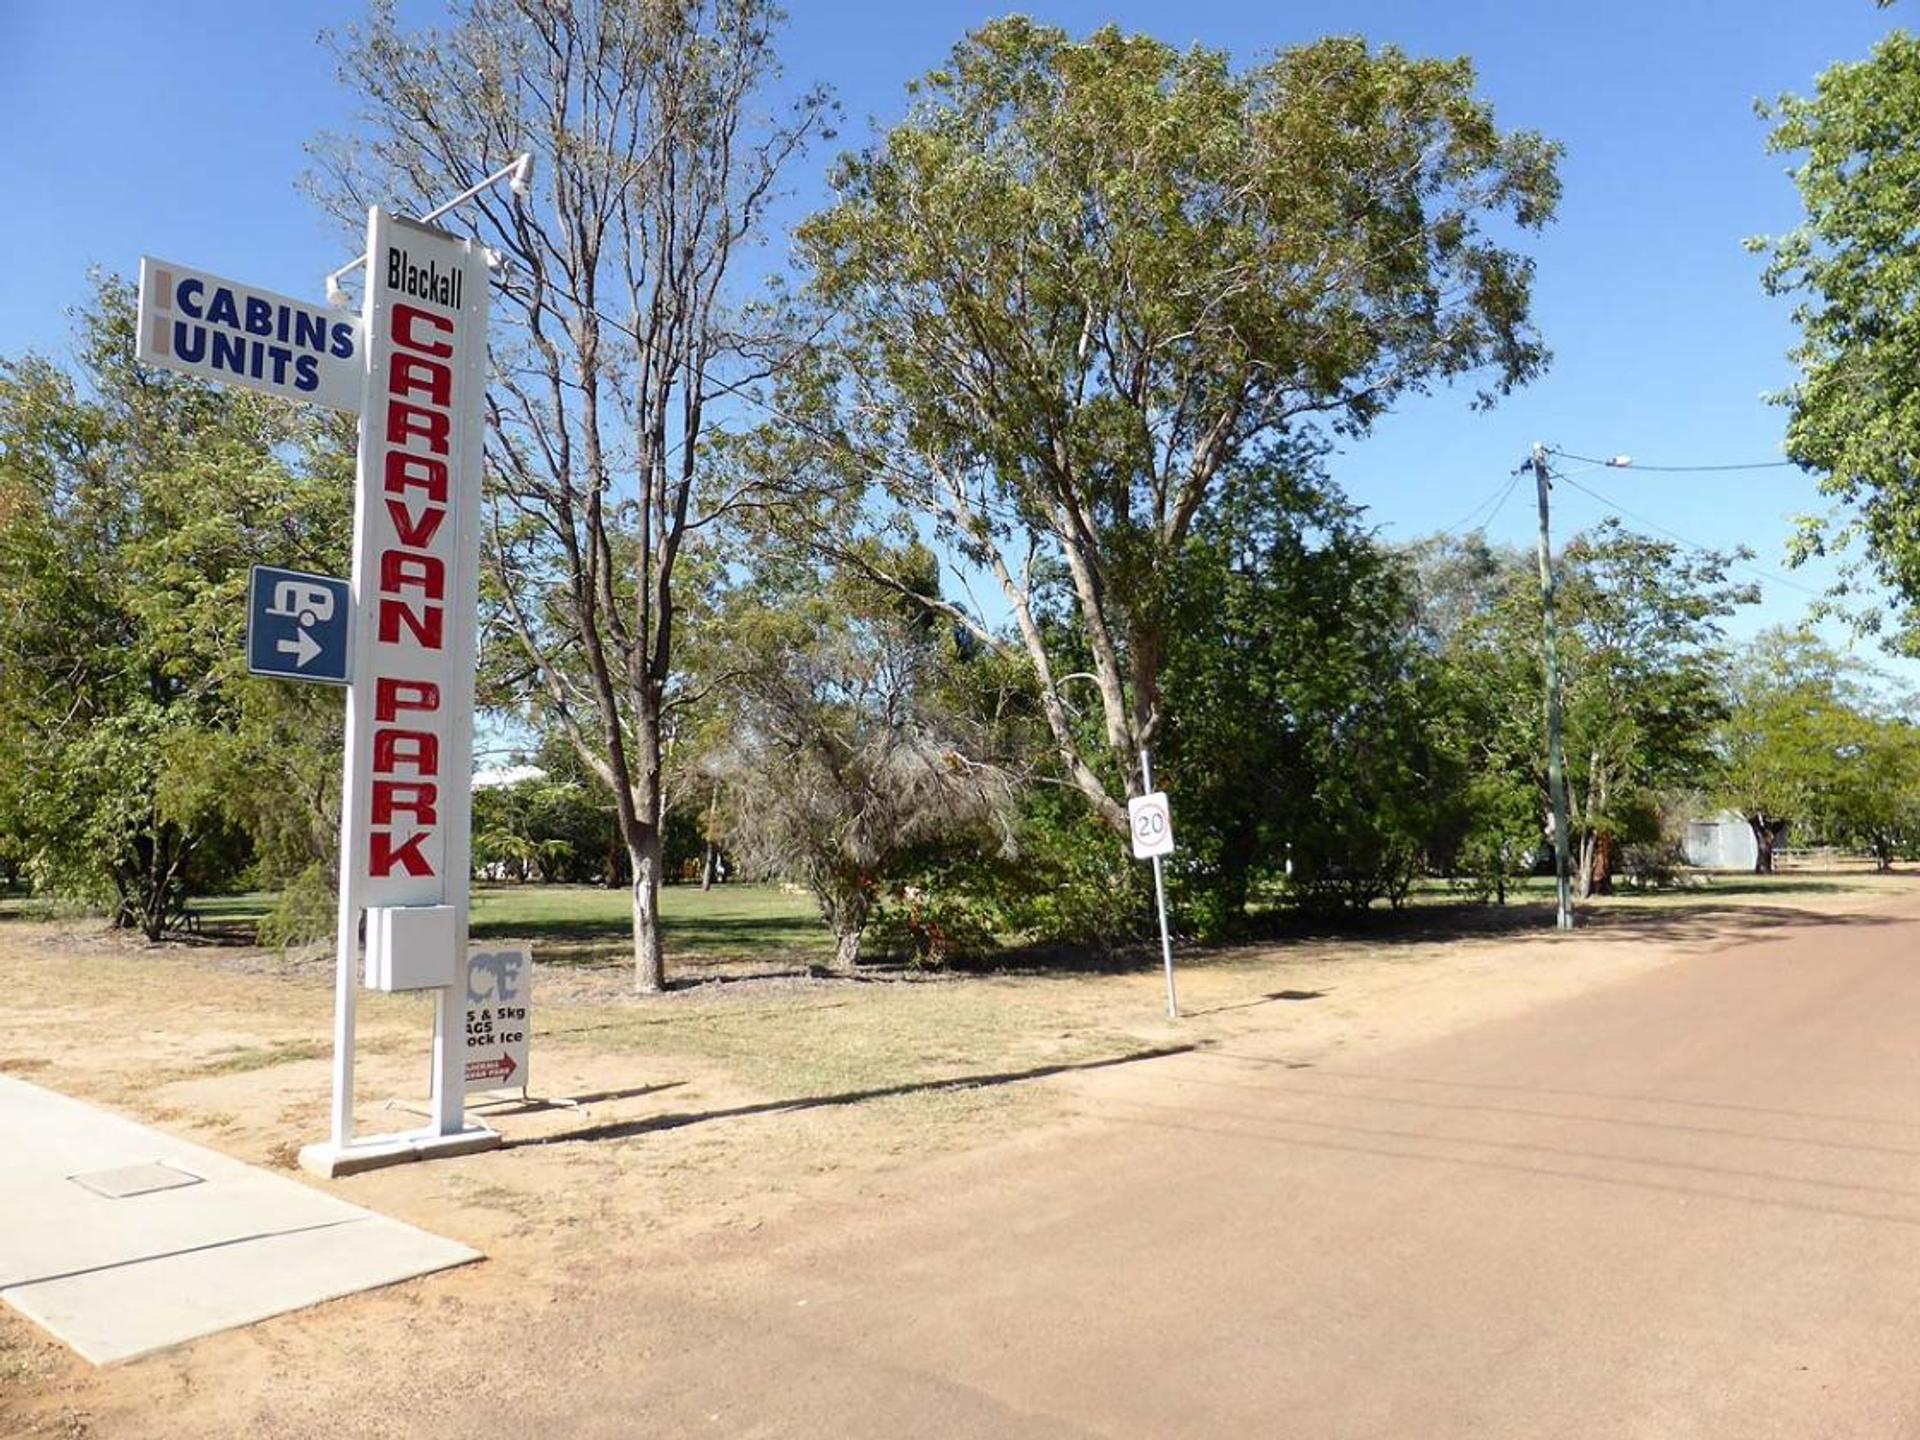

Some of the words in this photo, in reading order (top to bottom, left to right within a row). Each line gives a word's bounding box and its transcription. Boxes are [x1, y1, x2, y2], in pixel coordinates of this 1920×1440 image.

[388, 247, 463, 310] Blackall
[176, 278, 354, 359] CABINS
[173, 320, 319, 392] UNITS
[378, 303, 455, 650] CARAVAN
[369, 677, 440, 877] PARK
[1138, 812, 1164, 837] 20
[500, 1031, 523, 1044] Ice
